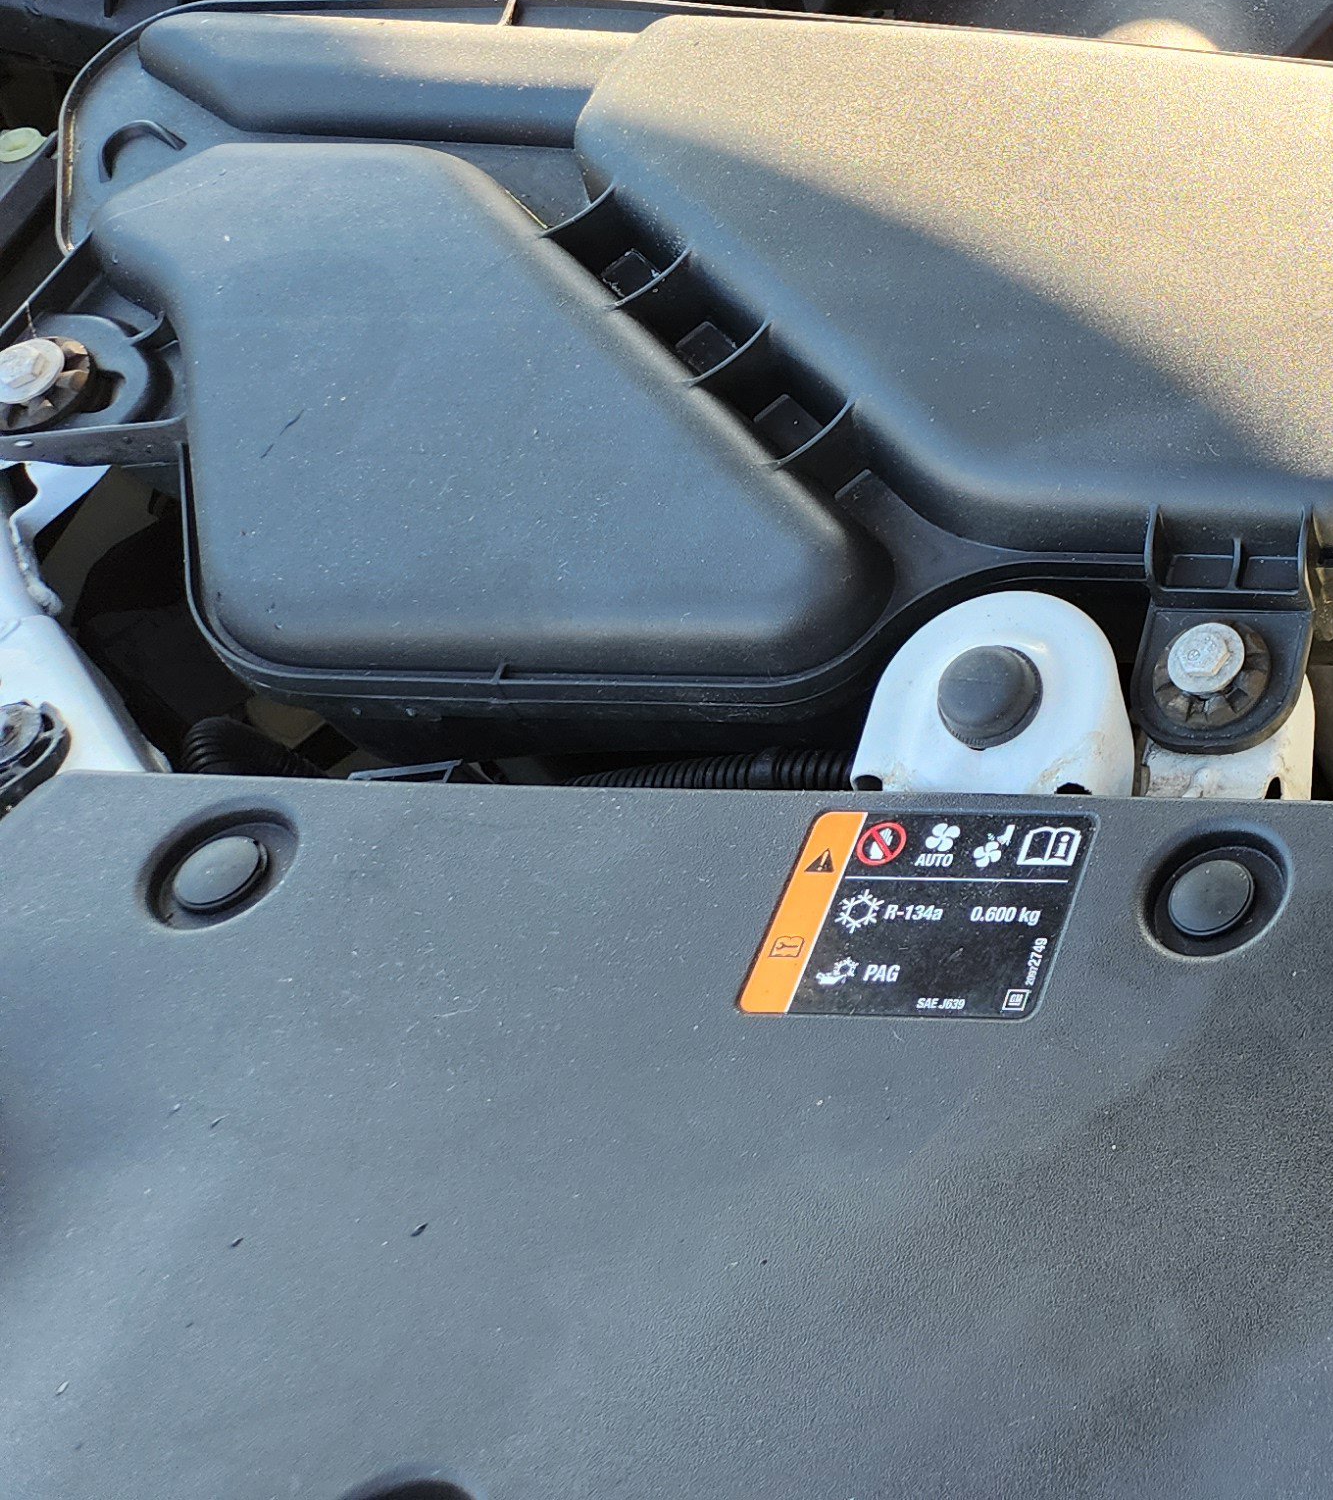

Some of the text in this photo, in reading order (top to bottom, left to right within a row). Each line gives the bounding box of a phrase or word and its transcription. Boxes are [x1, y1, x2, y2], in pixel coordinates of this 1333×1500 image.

[914, 853, 954, 868] AUTO
[884, 905, 1041, 926] R-134a 0.600 kg
[862, 964, 901, 983] PAG
[916, 997, 966, 1011] SAE J639
